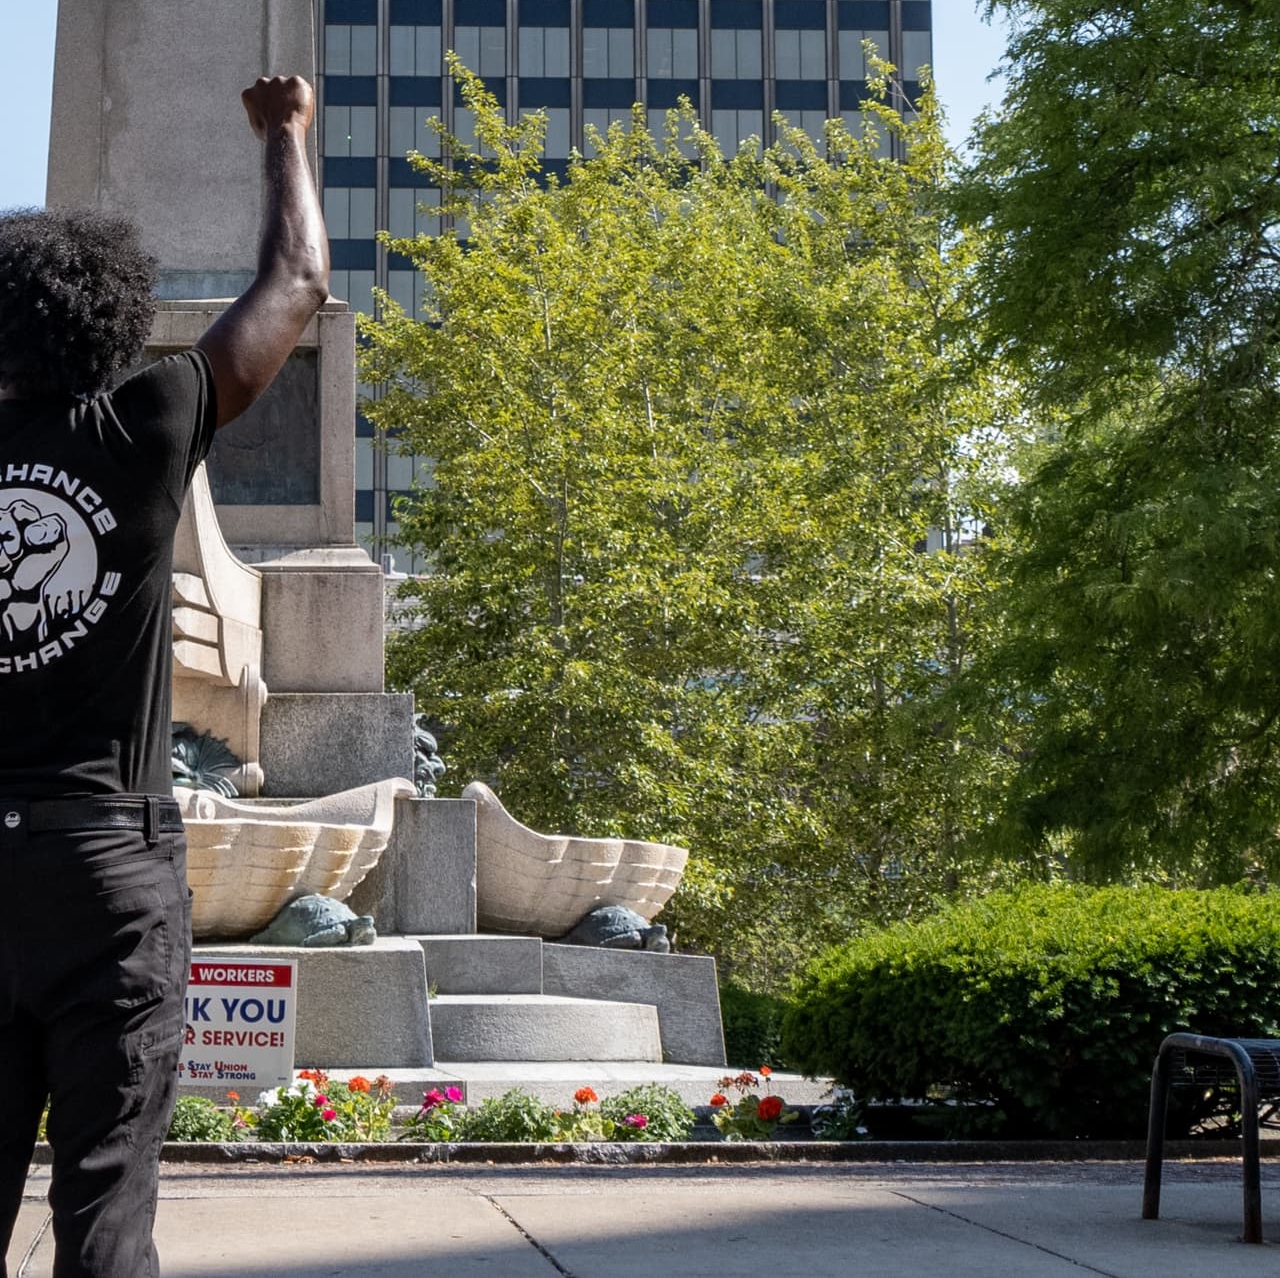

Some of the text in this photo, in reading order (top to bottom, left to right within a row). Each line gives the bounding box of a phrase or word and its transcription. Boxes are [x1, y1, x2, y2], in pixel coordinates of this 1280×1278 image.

[199, 968, 275, 983] WORKERS
[221, 998, 286, 1024] YOU
[202, 1030, 284, 1047] SERVICE!
